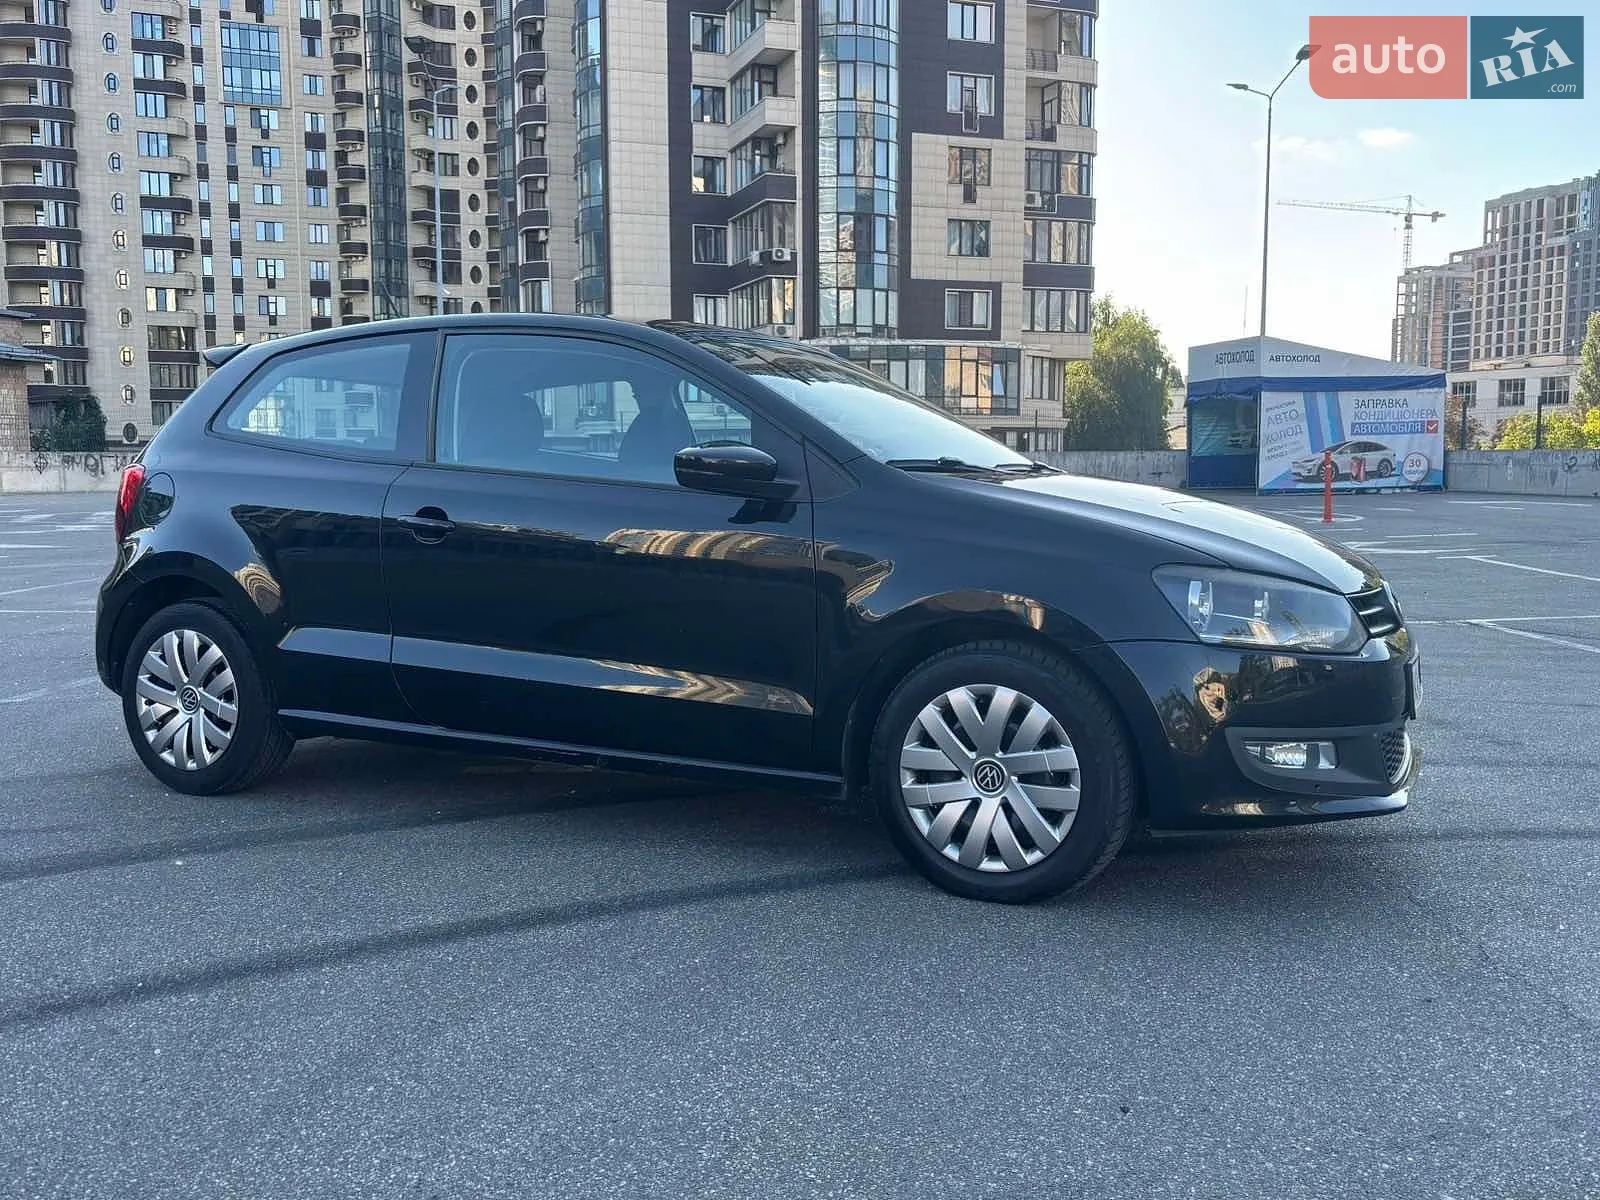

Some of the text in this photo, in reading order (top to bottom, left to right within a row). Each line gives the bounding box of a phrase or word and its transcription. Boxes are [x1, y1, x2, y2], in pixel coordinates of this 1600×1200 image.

[1215, 349, 1255, 364] АВТОХОЛОД
[1268, 354, 1321, 363] АВТОХОЛОД
[1353, 398, 1409, 409] ЗАПРАВКА
[1266, 408, 1299, 426] АВТО
[1353, 408, 1439, 421] КОНДИЦІОНЕРА
[1264, 424, 1304, 444] ХОЛОД
[1353, 422, 1421, 434] АВТОМОБІЛЯ
[1408, 458, 1421, 468] 30
